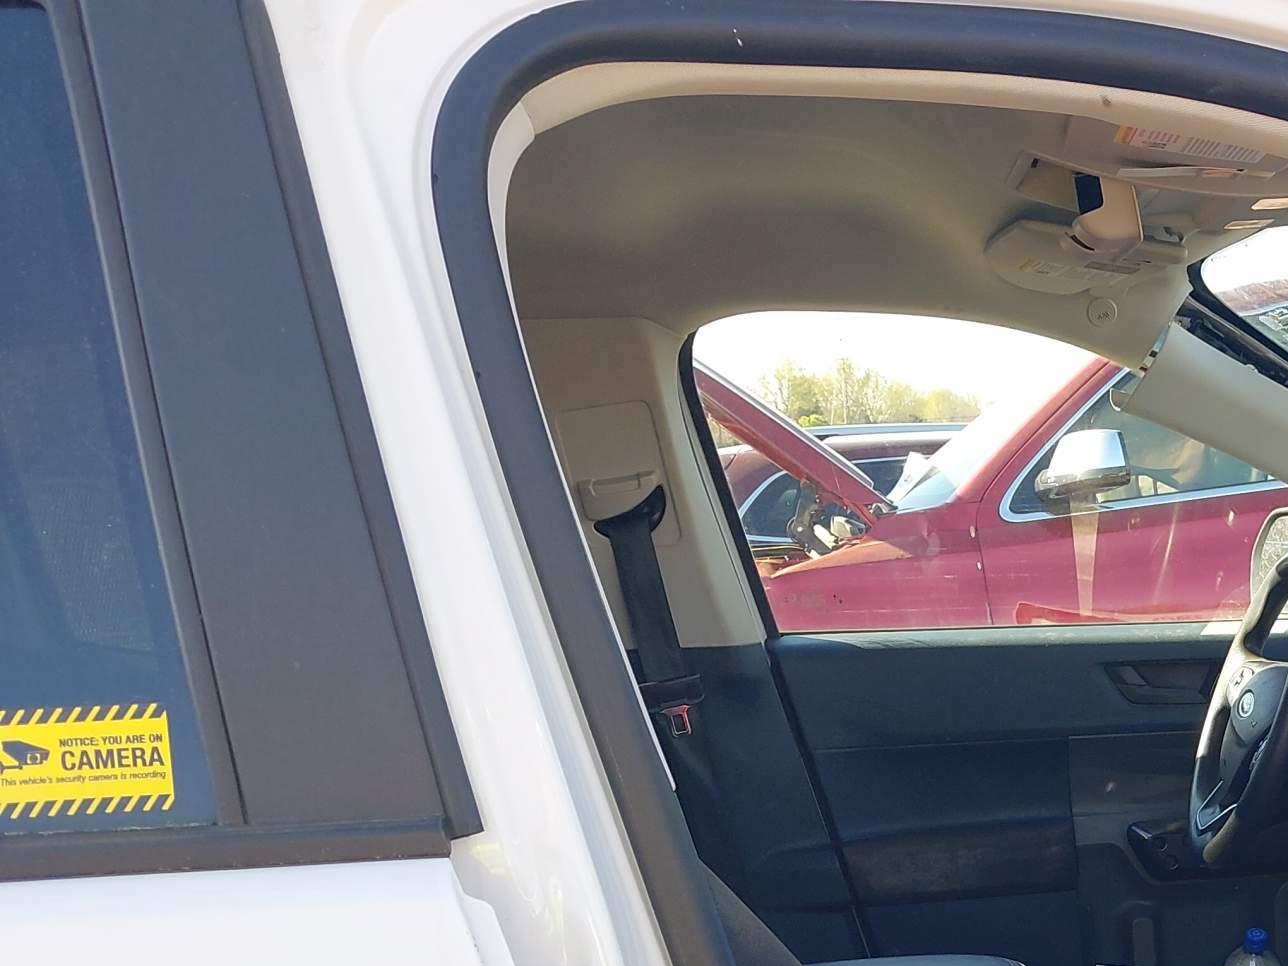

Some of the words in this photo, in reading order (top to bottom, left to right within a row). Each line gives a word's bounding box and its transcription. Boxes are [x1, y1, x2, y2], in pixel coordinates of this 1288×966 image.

[59, 737, 99, 748] NOTICE:
[101, 735, 122, 746] YOU
[125, 734, 145, 744] ARE
[148, 733, 163, 743] ON
[61, 746, 165, 771] CAMERA
[1, 778, 17, 787] This
[19, 775, 53, 785] vehicle's
[55, 774, 86, 784] security
[88, 773, 118, 782] camera
[120, 772, 127, 780] is
[129, 770, 166, 780] recording
